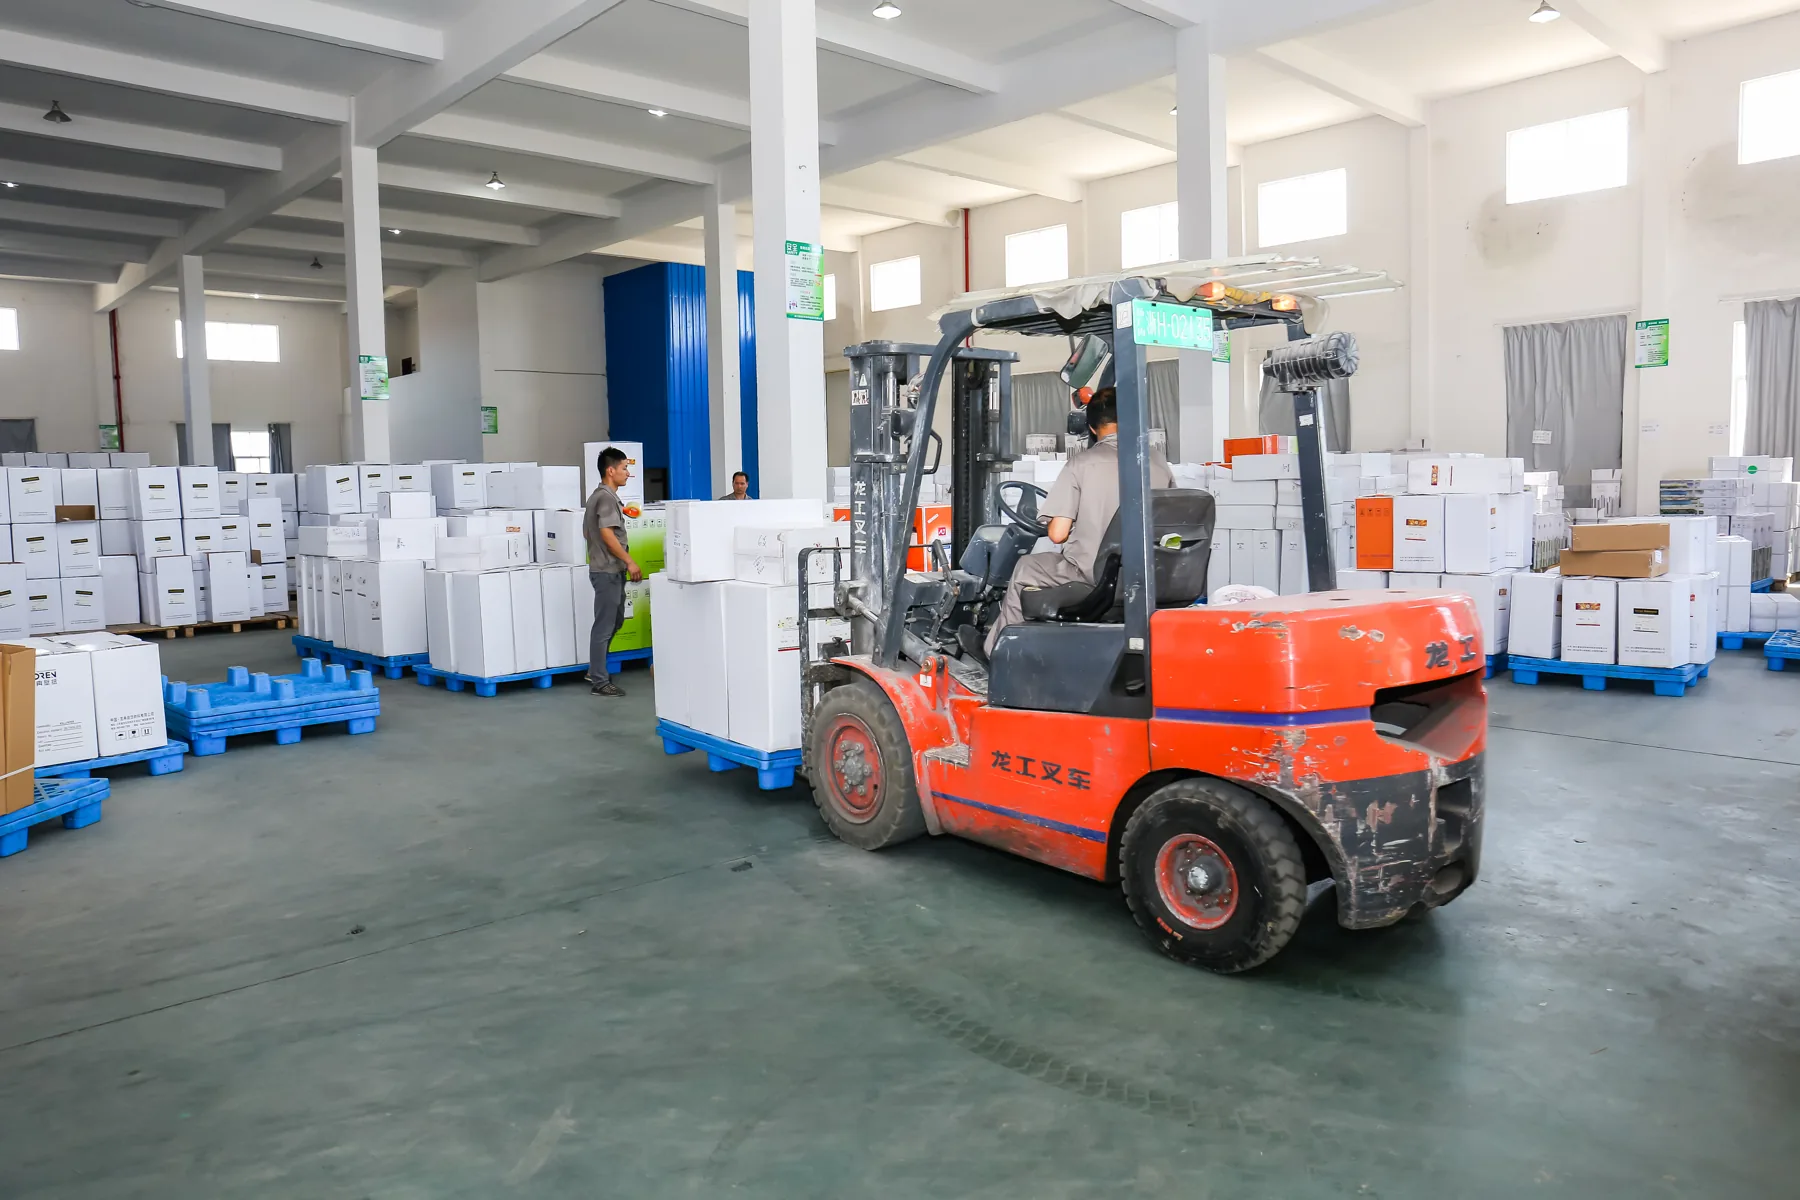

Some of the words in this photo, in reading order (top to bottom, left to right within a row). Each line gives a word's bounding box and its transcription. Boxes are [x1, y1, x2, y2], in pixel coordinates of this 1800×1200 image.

[854, 481, 867, 554] 龙工叉车
[1425, 634, 1477, 669] 龙工
[991, 750, 1090, 790] 龙工叉车
